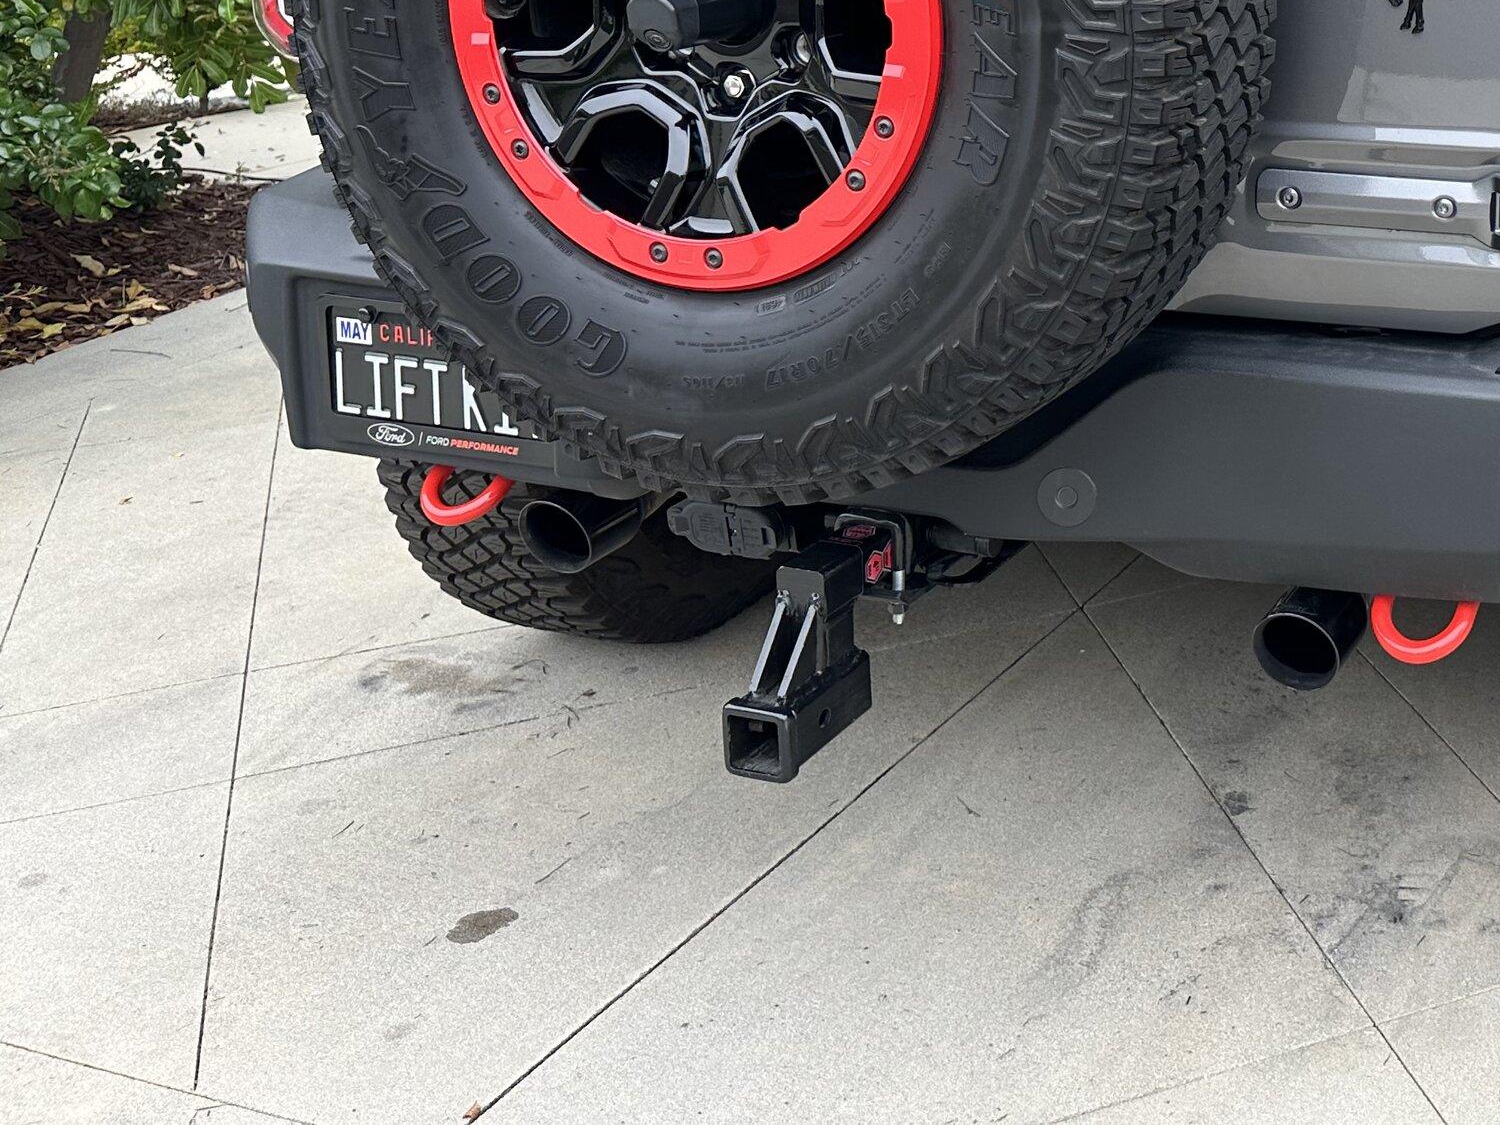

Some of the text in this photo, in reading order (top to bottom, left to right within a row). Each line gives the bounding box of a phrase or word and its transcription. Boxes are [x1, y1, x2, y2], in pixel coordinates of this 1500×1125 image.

[340, 320, 369, 341] MAY
[334, 347, 448, 426] LIFT
[374, 424, 407, 444] Ford
[426, 435, 520, 456] FORD PERFORMANCE
